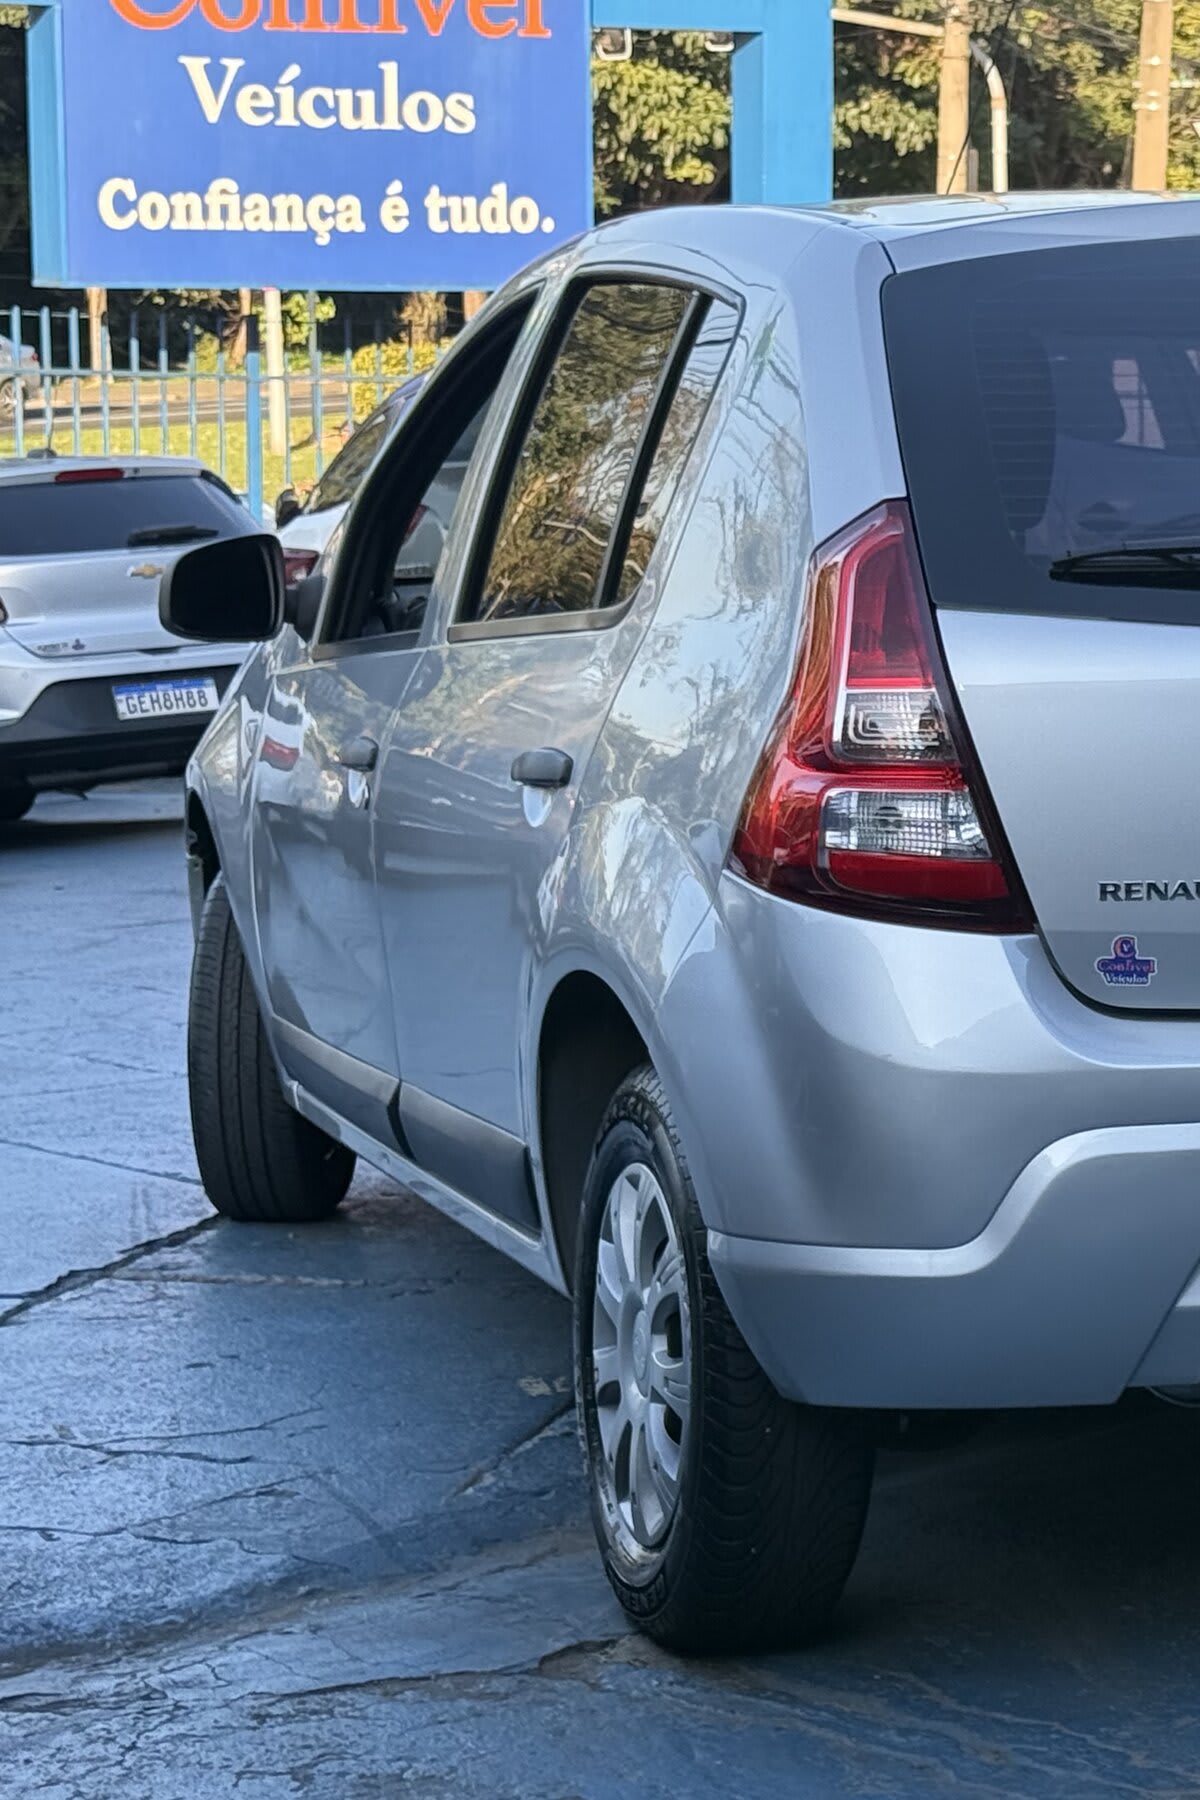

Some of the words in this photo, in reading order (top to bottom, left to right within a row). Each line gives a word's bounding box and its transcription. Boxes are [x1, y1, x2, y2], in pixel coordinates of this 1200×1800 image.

[178, 55, 476, 134] Veículos
[98, 177, 366, 246] Confiança
[380, 180, 409, 233] é
[424, 182, 556, 234] tudo.
